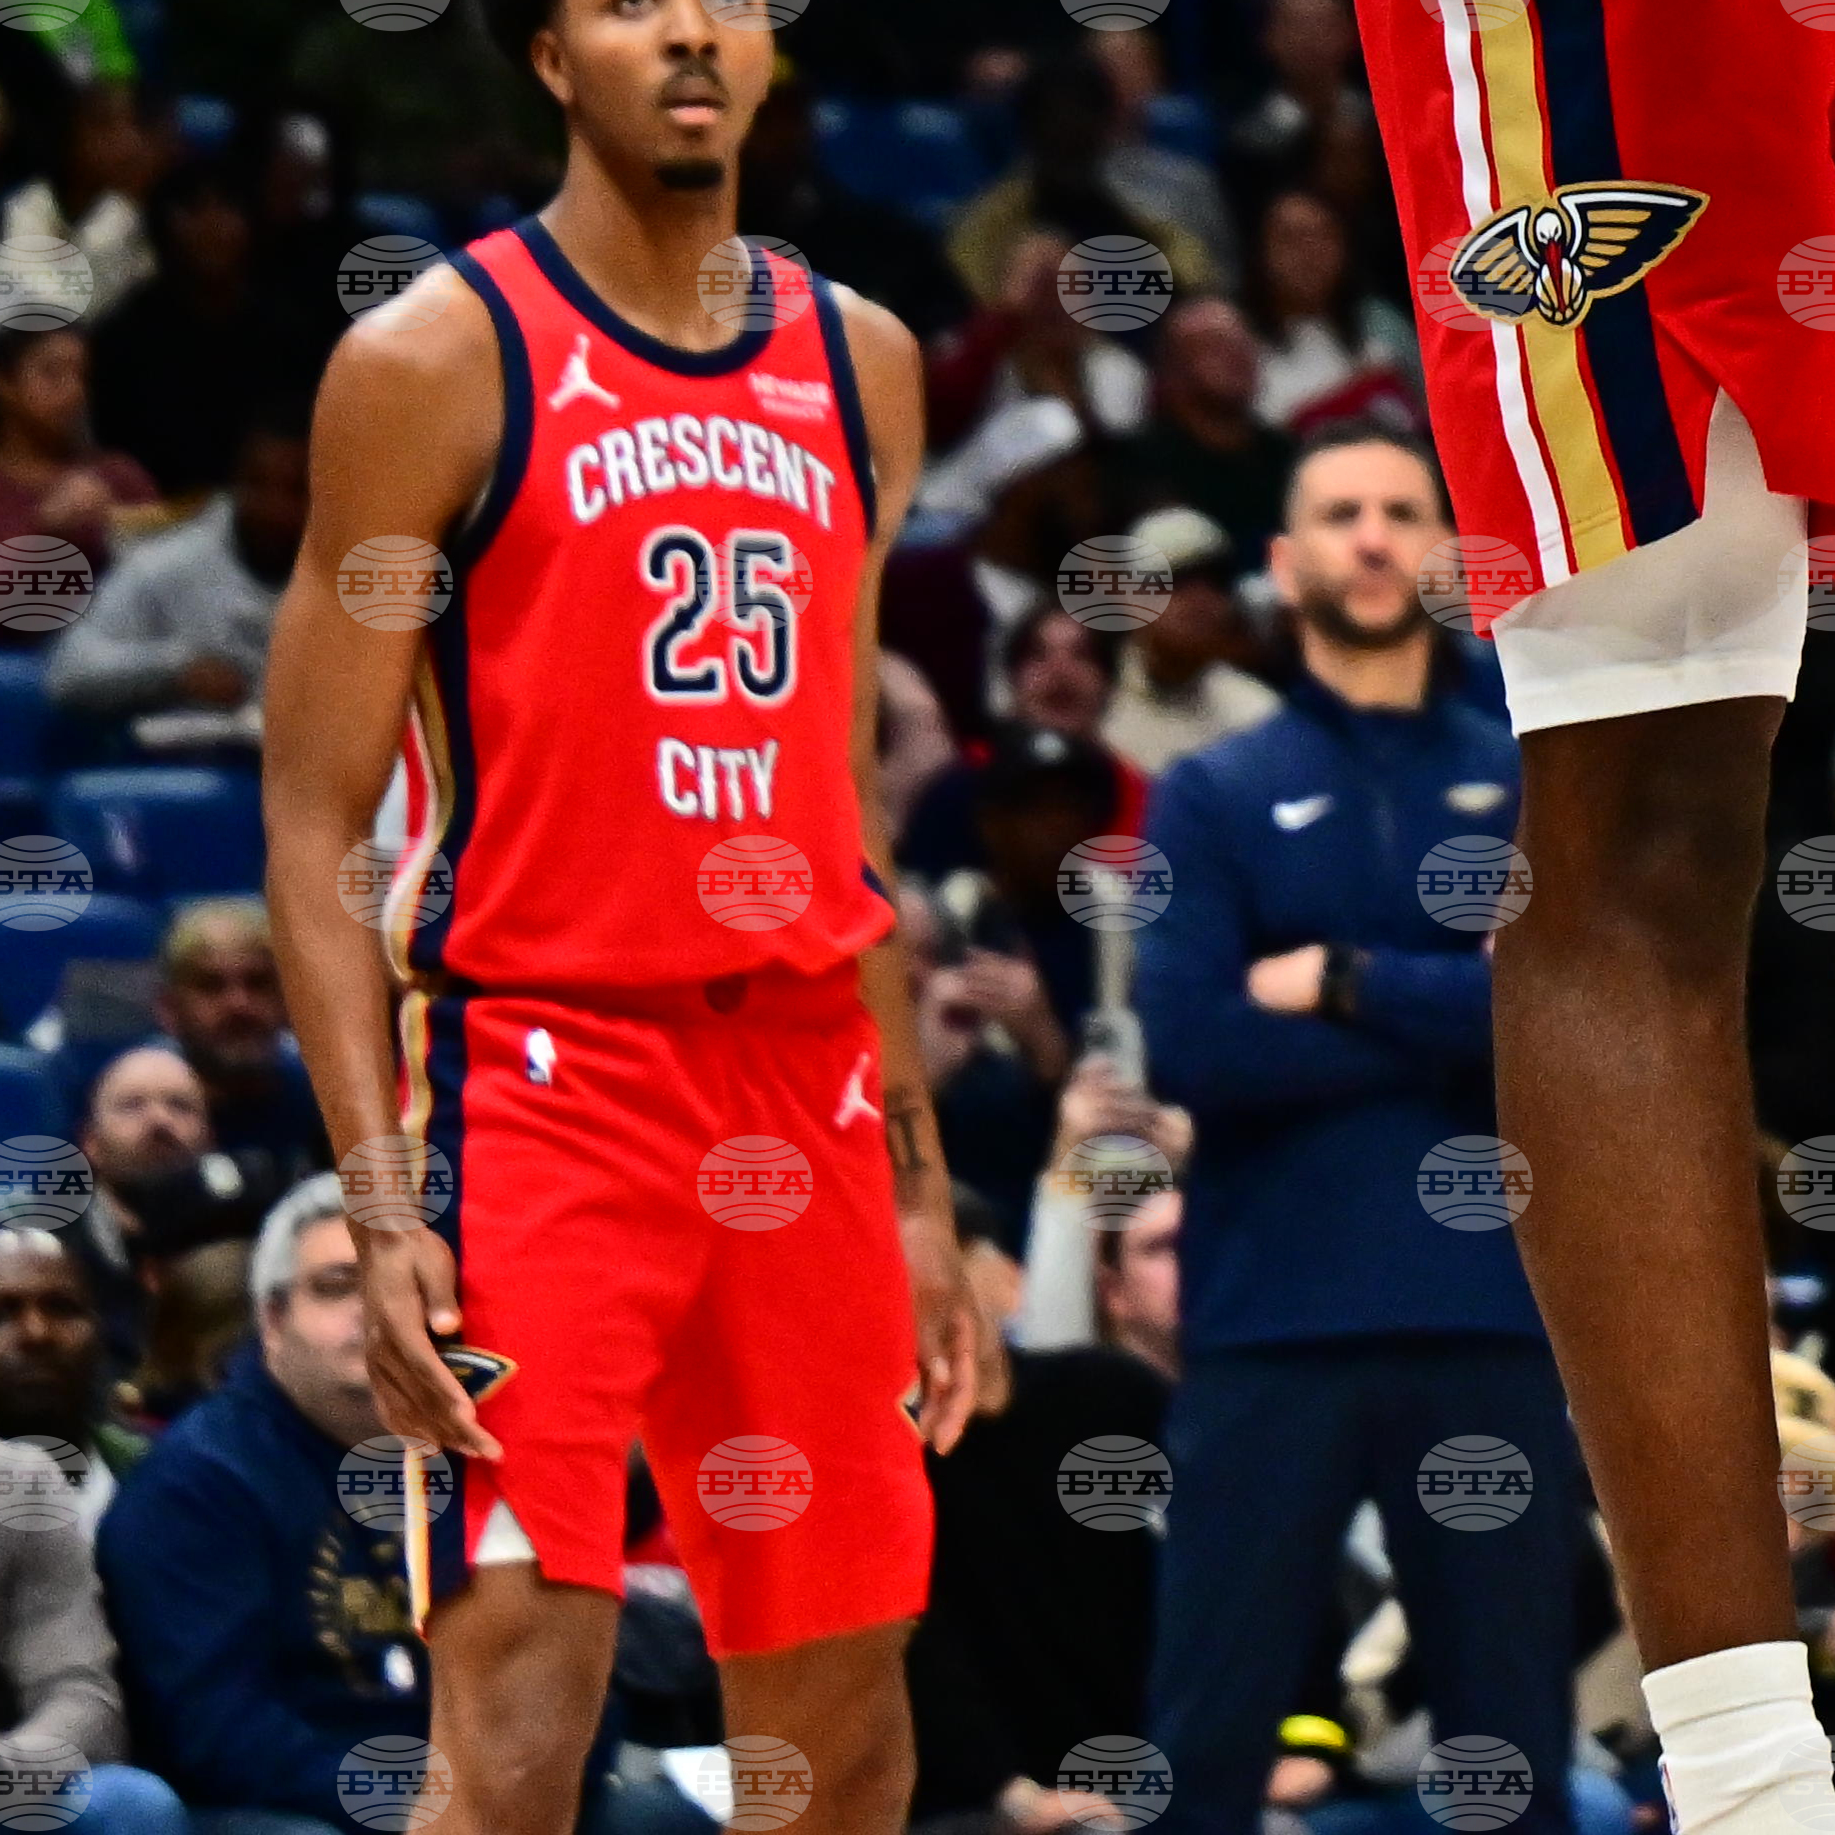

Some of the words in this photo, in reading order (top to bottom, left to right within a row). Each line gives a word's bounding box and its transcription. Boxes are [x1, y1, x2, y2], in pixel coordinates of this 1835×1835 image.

[566, 413, 836, 531] CRESCENT
[638, 525, 798, 709] 25
[656, 737, 781, 823] CITY
